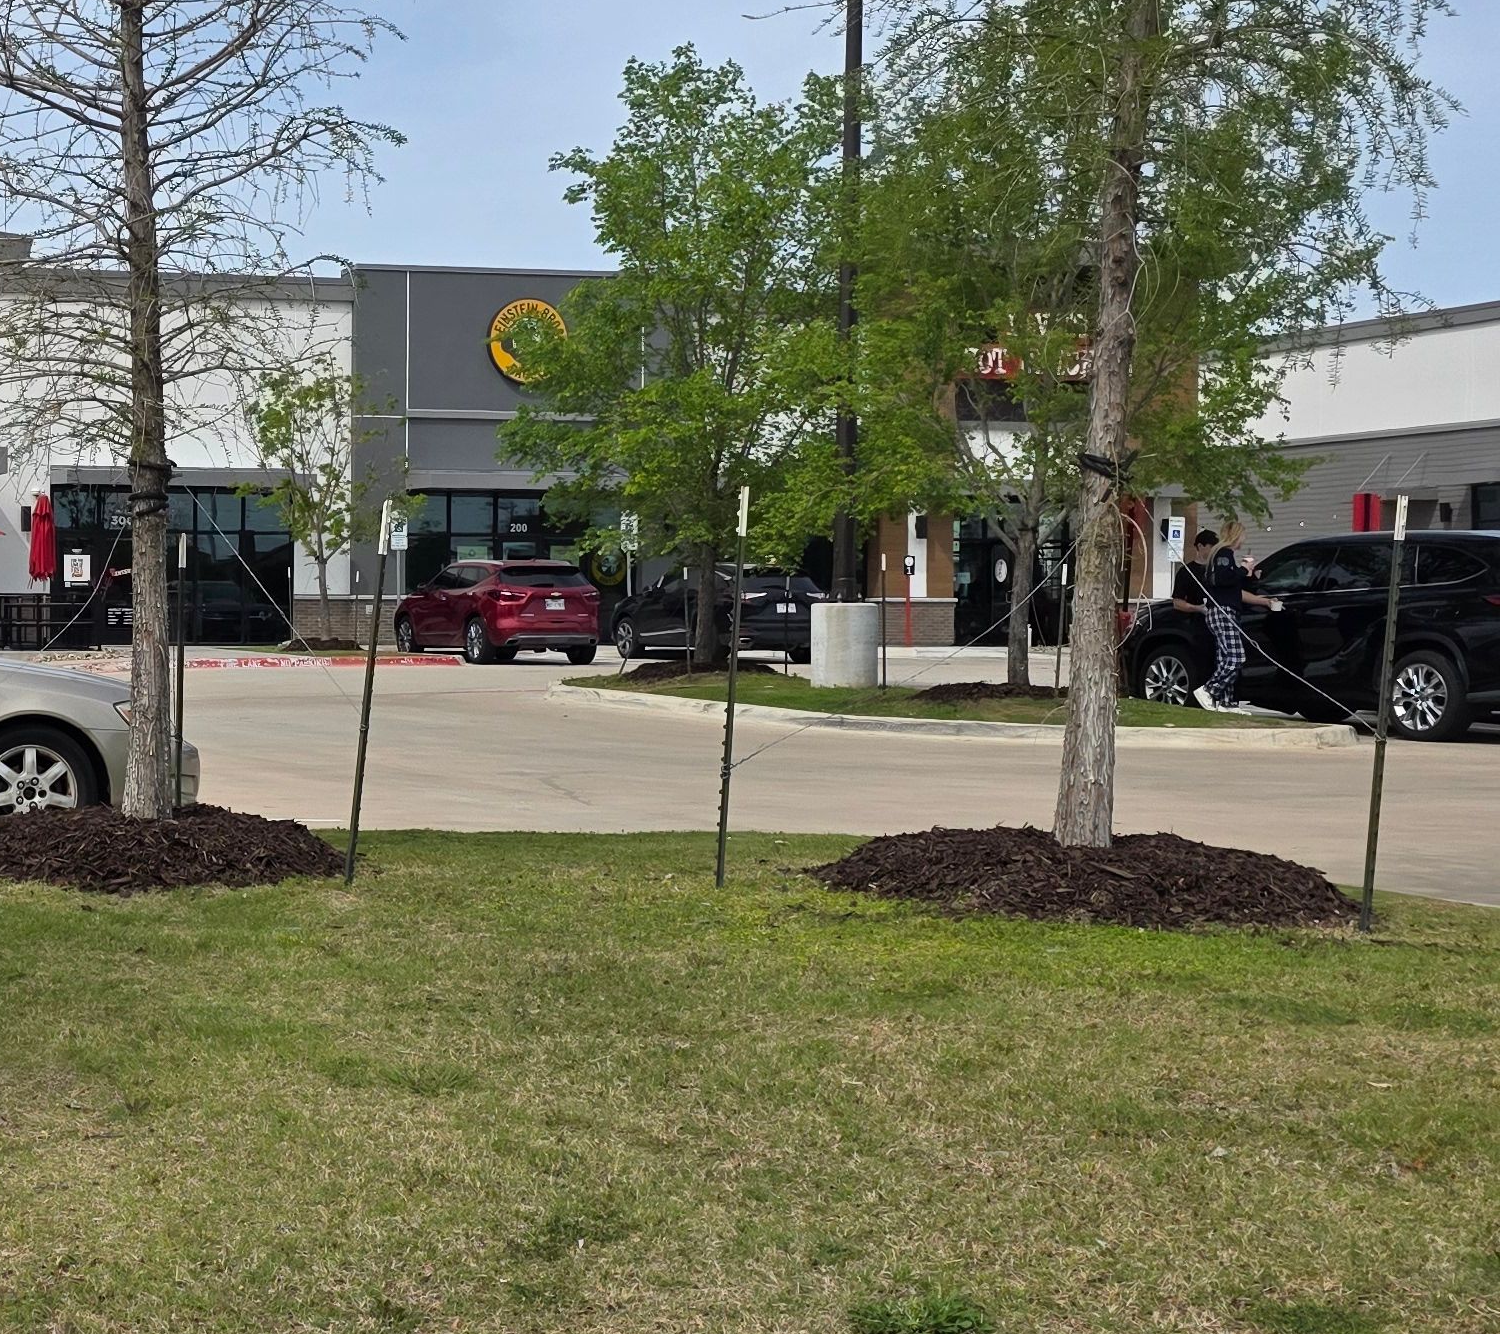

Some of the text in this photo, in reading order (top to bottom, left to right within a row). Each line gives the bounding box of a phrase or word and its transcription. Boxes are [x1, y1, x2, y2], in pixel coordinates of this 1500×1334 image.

[494, 302, 538, 334] EINSTEIN
[510, 523, 528, 533] 200
[906, 566, 913, 575] 1
